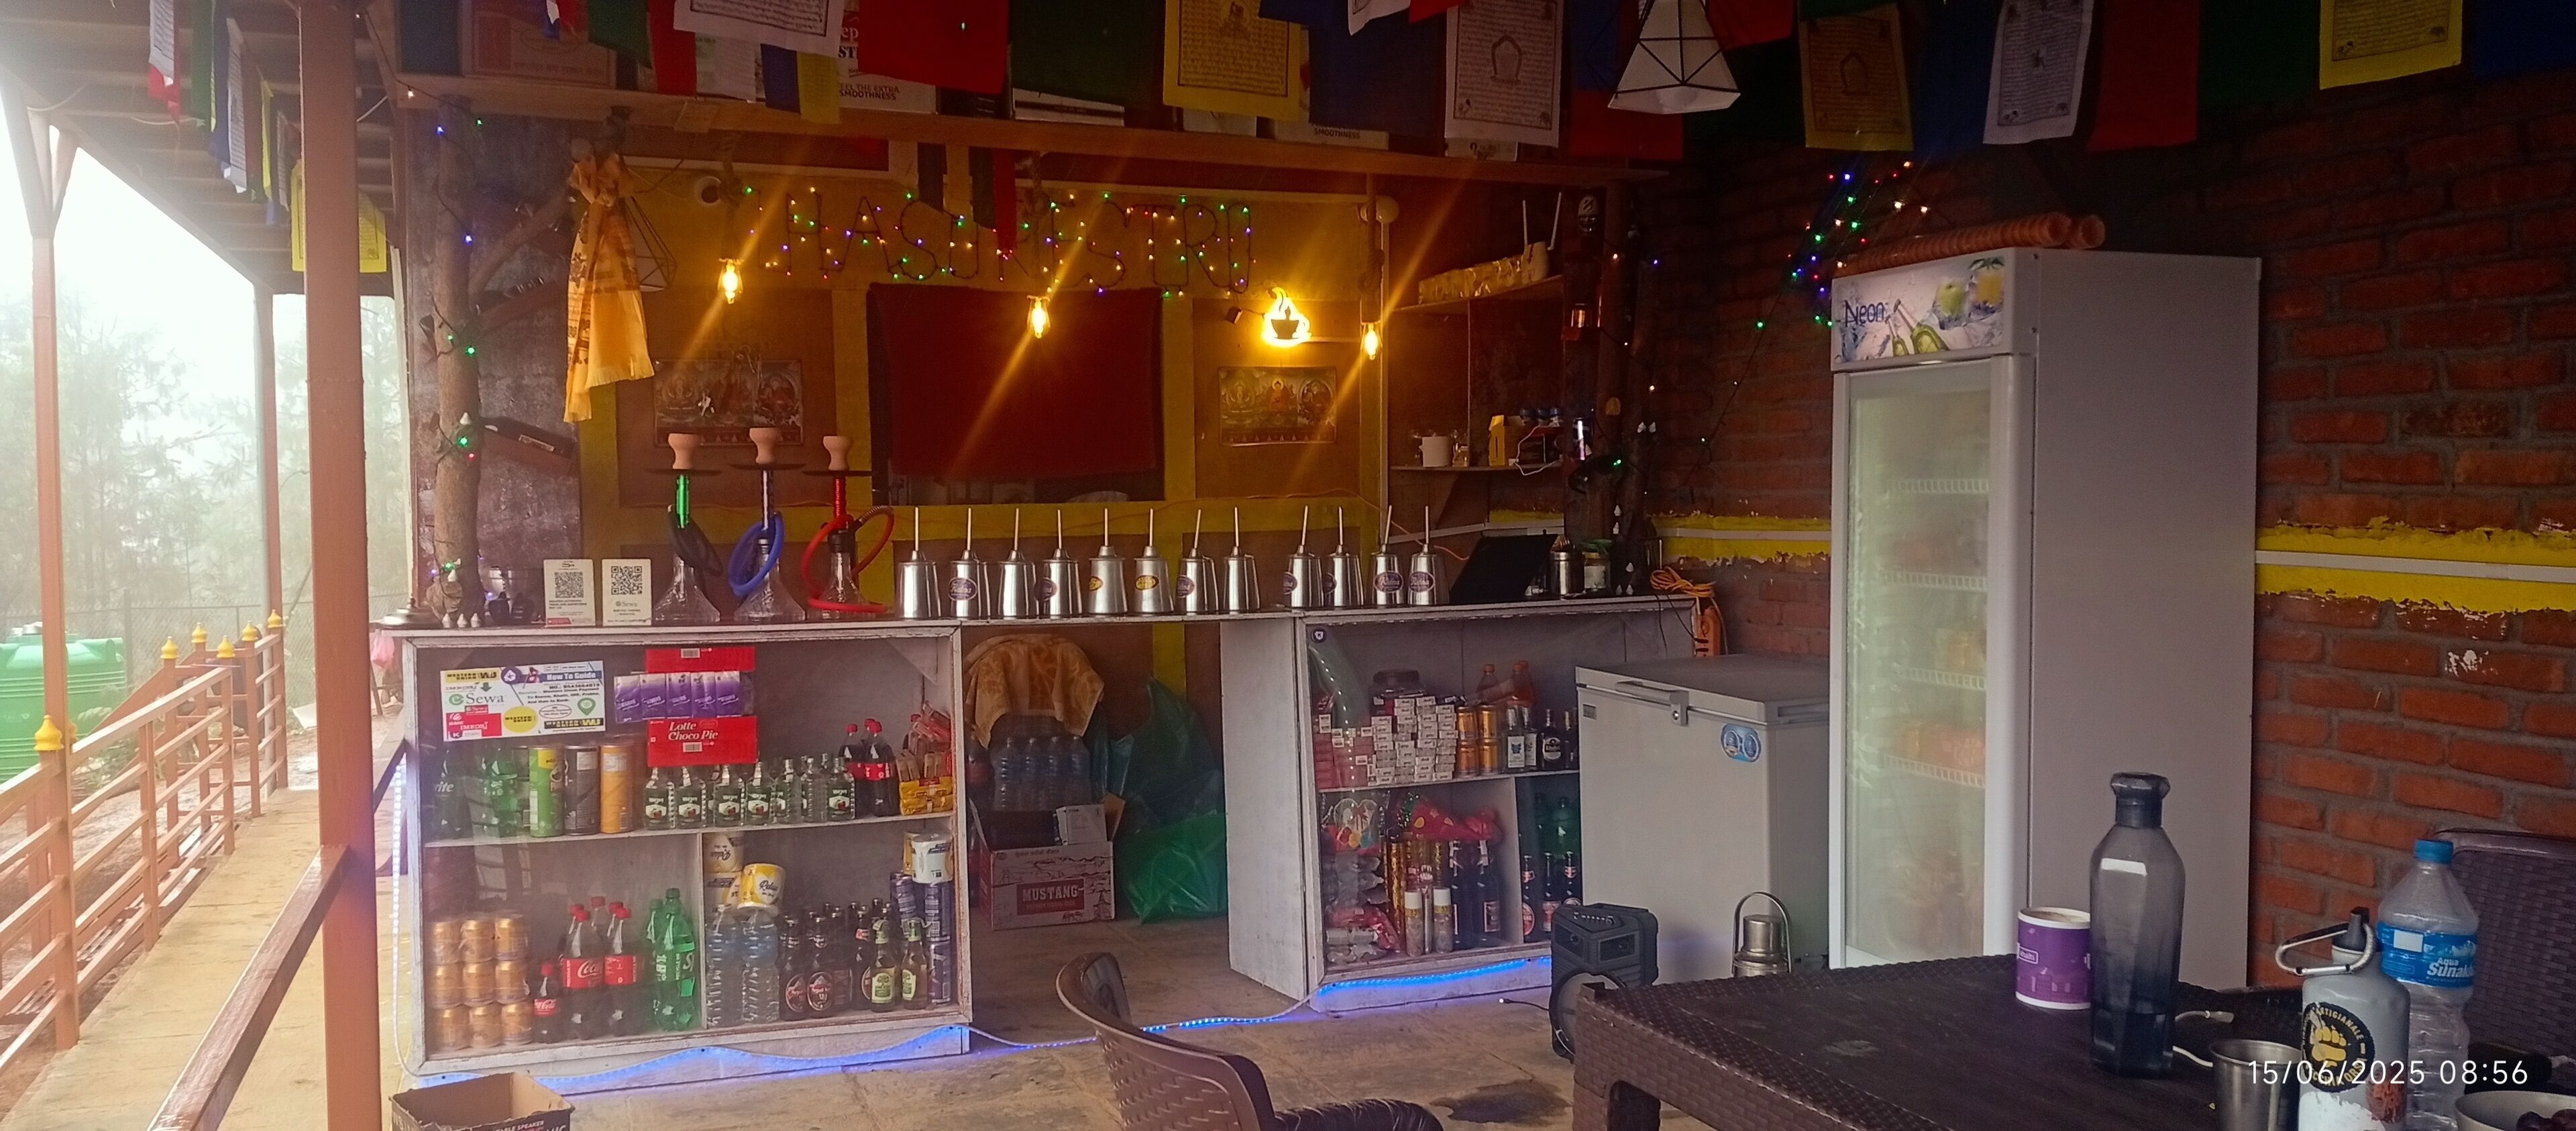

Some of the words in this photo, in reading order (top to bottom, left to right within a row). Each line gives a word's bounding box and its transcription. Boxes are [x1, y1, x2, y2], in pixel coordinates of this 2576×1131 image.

[841, 27, 859, 42] ep
[1844, 300, 1885, 327] Neon
[669, 722, 697, 731] Lotte
[668, 731, 700, 741] Choco
[701, 729, 718, 740] Pie
[437, 781, 455, 793] rite
[1022, 885, 1079, 902] MUSTANG
[2436, 957, 2459, 967] Aqua
[517, 1120, 545, 1130] SPEAKER
